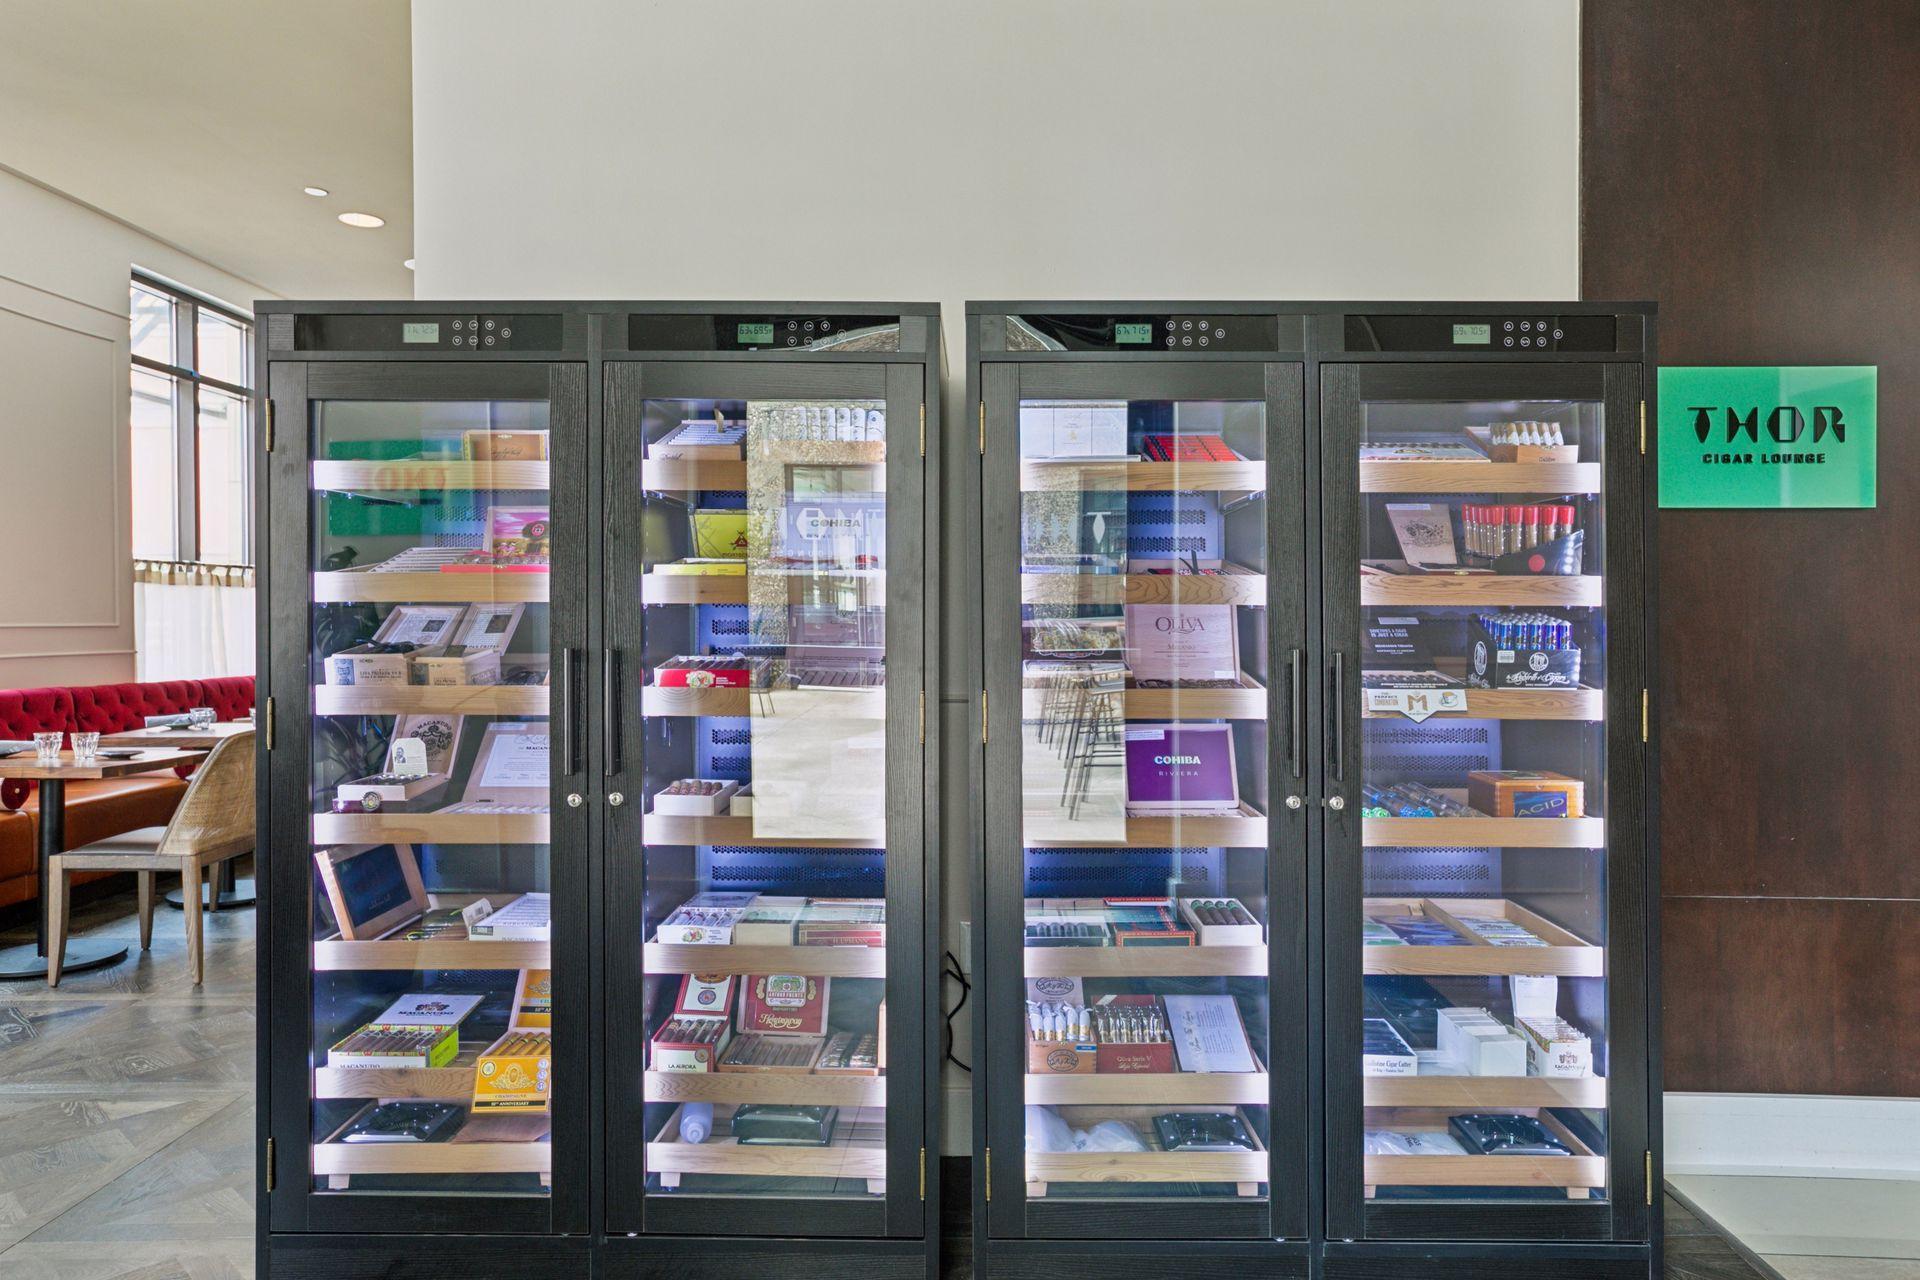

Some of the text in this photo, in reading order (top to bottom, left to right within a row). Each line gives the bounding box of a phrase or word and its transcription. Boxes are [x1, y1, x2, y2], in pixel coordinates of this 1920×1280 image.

[1687, 406, 1846, 443] THOR
[1702, 453, 1826, 464] CIGAR LOUNGE
[810, 518, 862, 528] COHIBA
[1155, 616, 1205, 635] OLIVA
[1153, 755, 1202, 765] COHIBA
[1516, 798, 1565, 818] ACID
[758, 1013, 803, 1029] Hemingway
